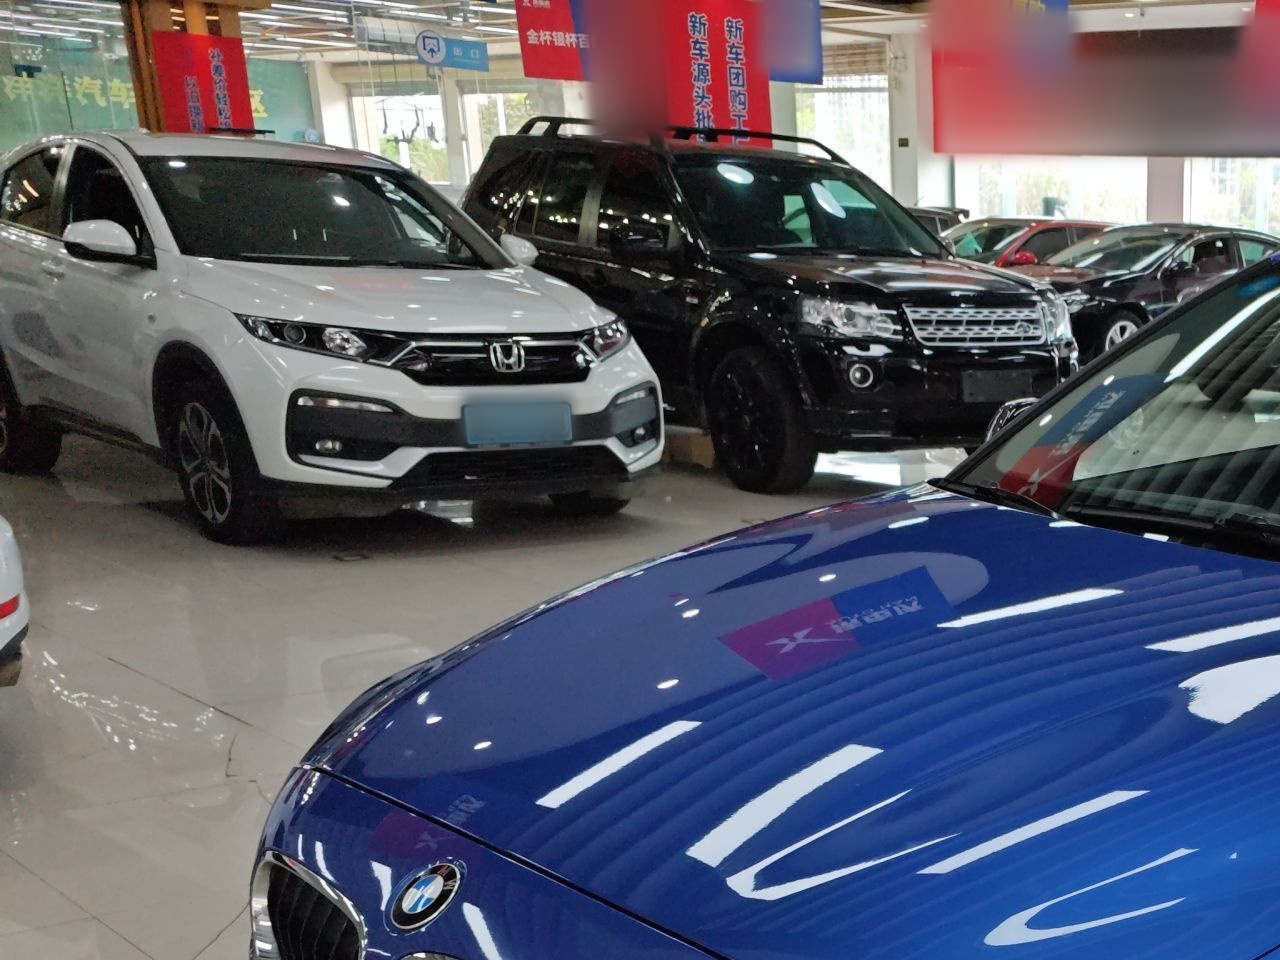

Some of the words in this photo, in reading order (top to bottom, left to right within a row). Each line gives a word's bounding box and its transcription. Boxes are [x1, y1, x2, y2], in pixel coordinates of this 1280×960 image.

[687, 11, 715, 142] 新车源头批
